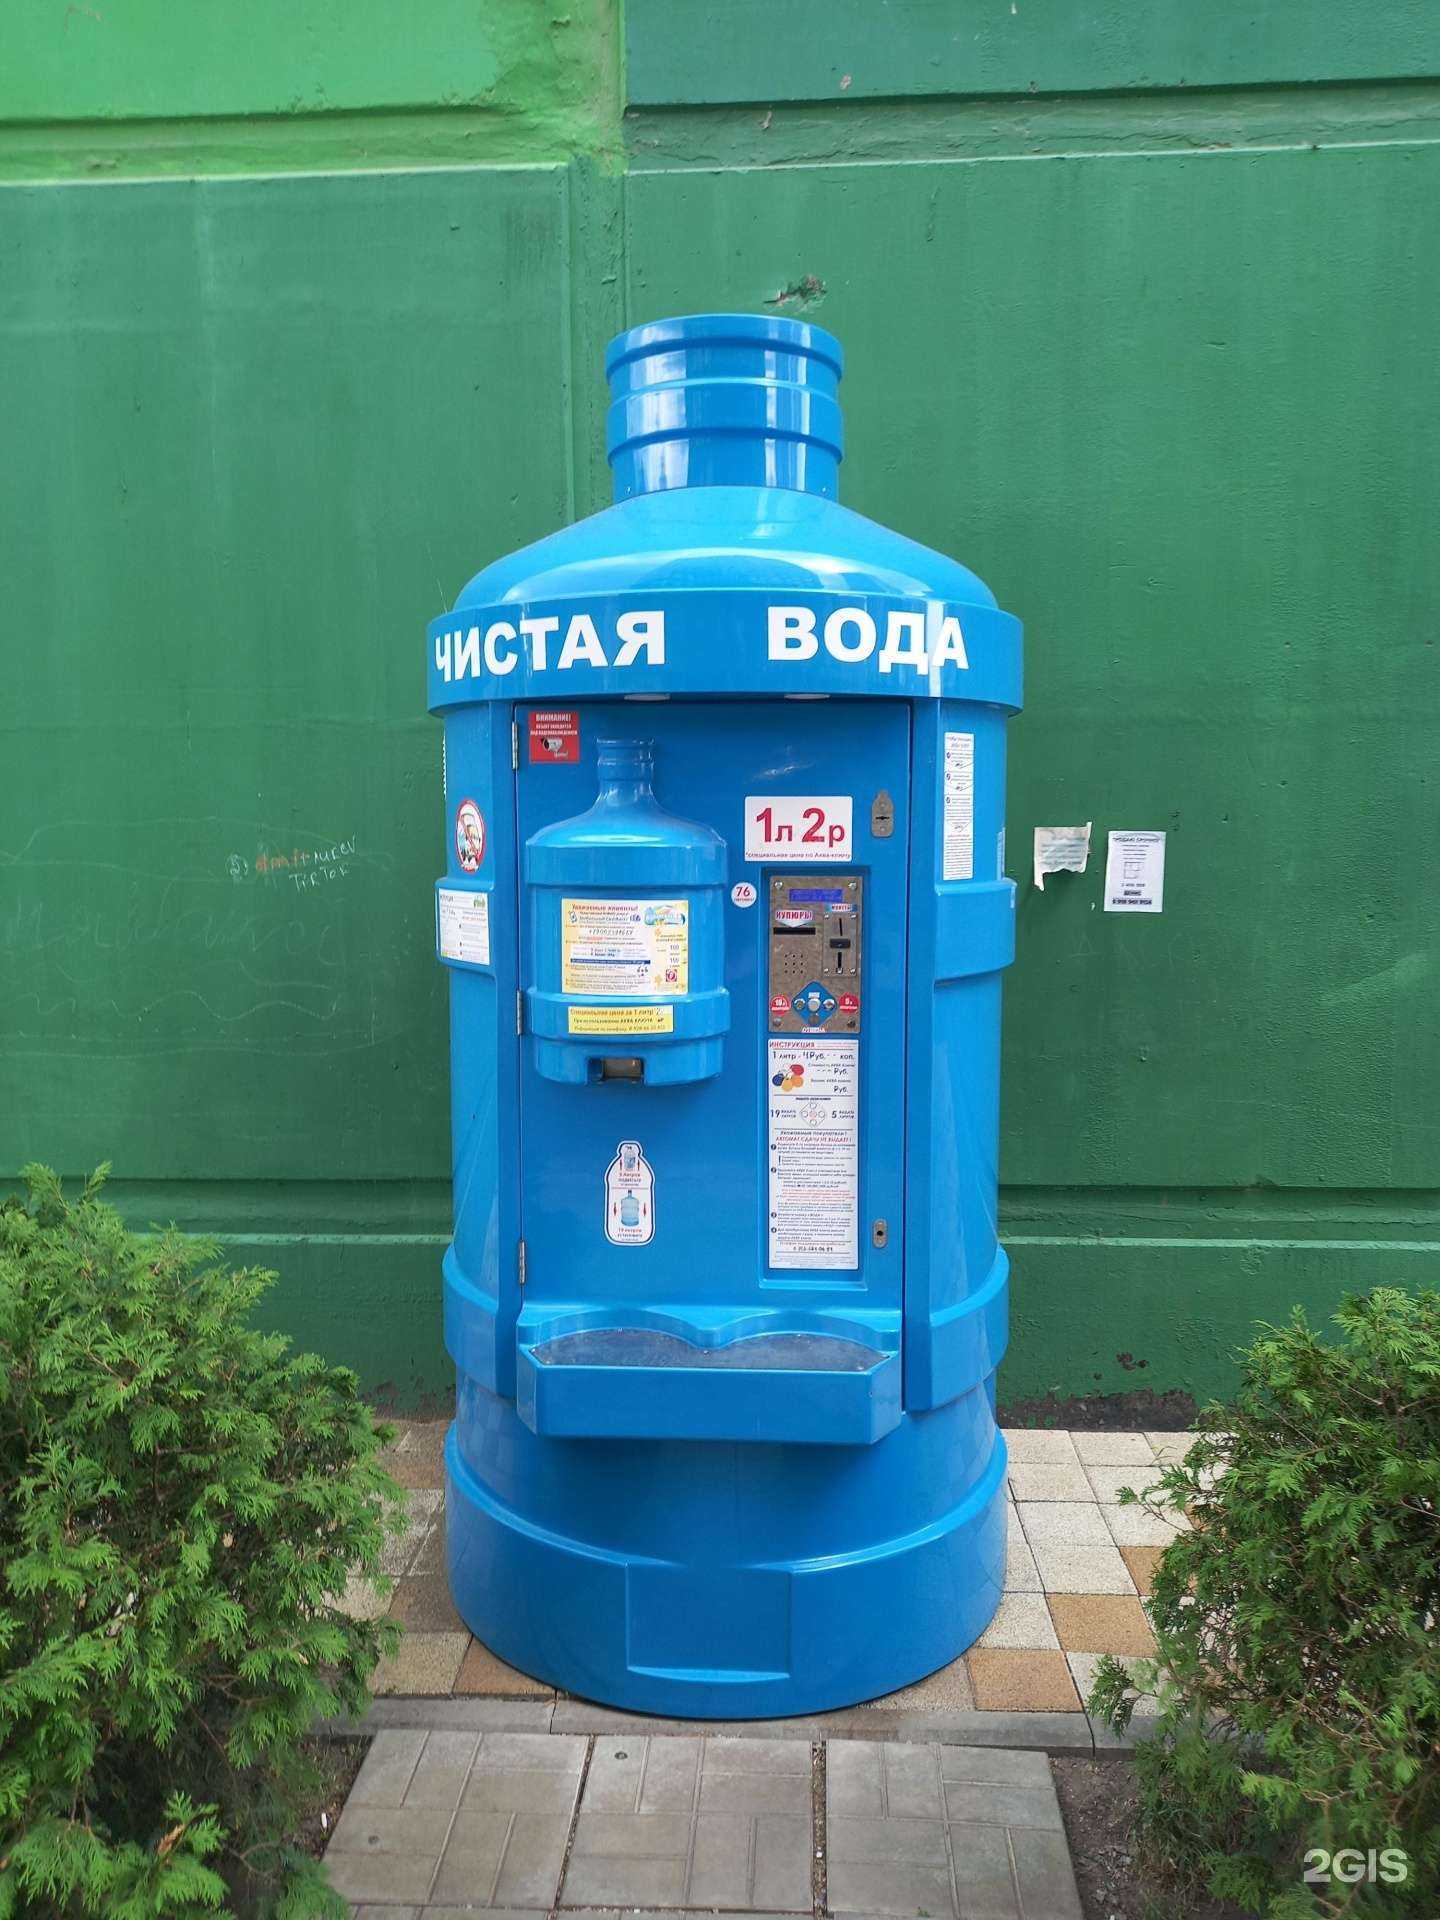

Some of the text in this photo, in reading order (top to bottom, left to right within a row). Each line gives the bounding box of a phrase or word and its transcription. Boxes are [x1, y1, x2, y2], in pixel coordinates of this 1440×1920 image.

[435, 606, 969, 683] ЧИСТАЯ ВОДА
[756, 807, 845, 848] 1л 2р
[736, 886, 751, 897] 76
[776, 911, 813, 920] КУПЮРЫ
[769, 1041, 815, 1049] ИНСТРУКЦИЯ
[770, 1109, 781, 1118] 19
[831, 1110, 837, 1119] 5
